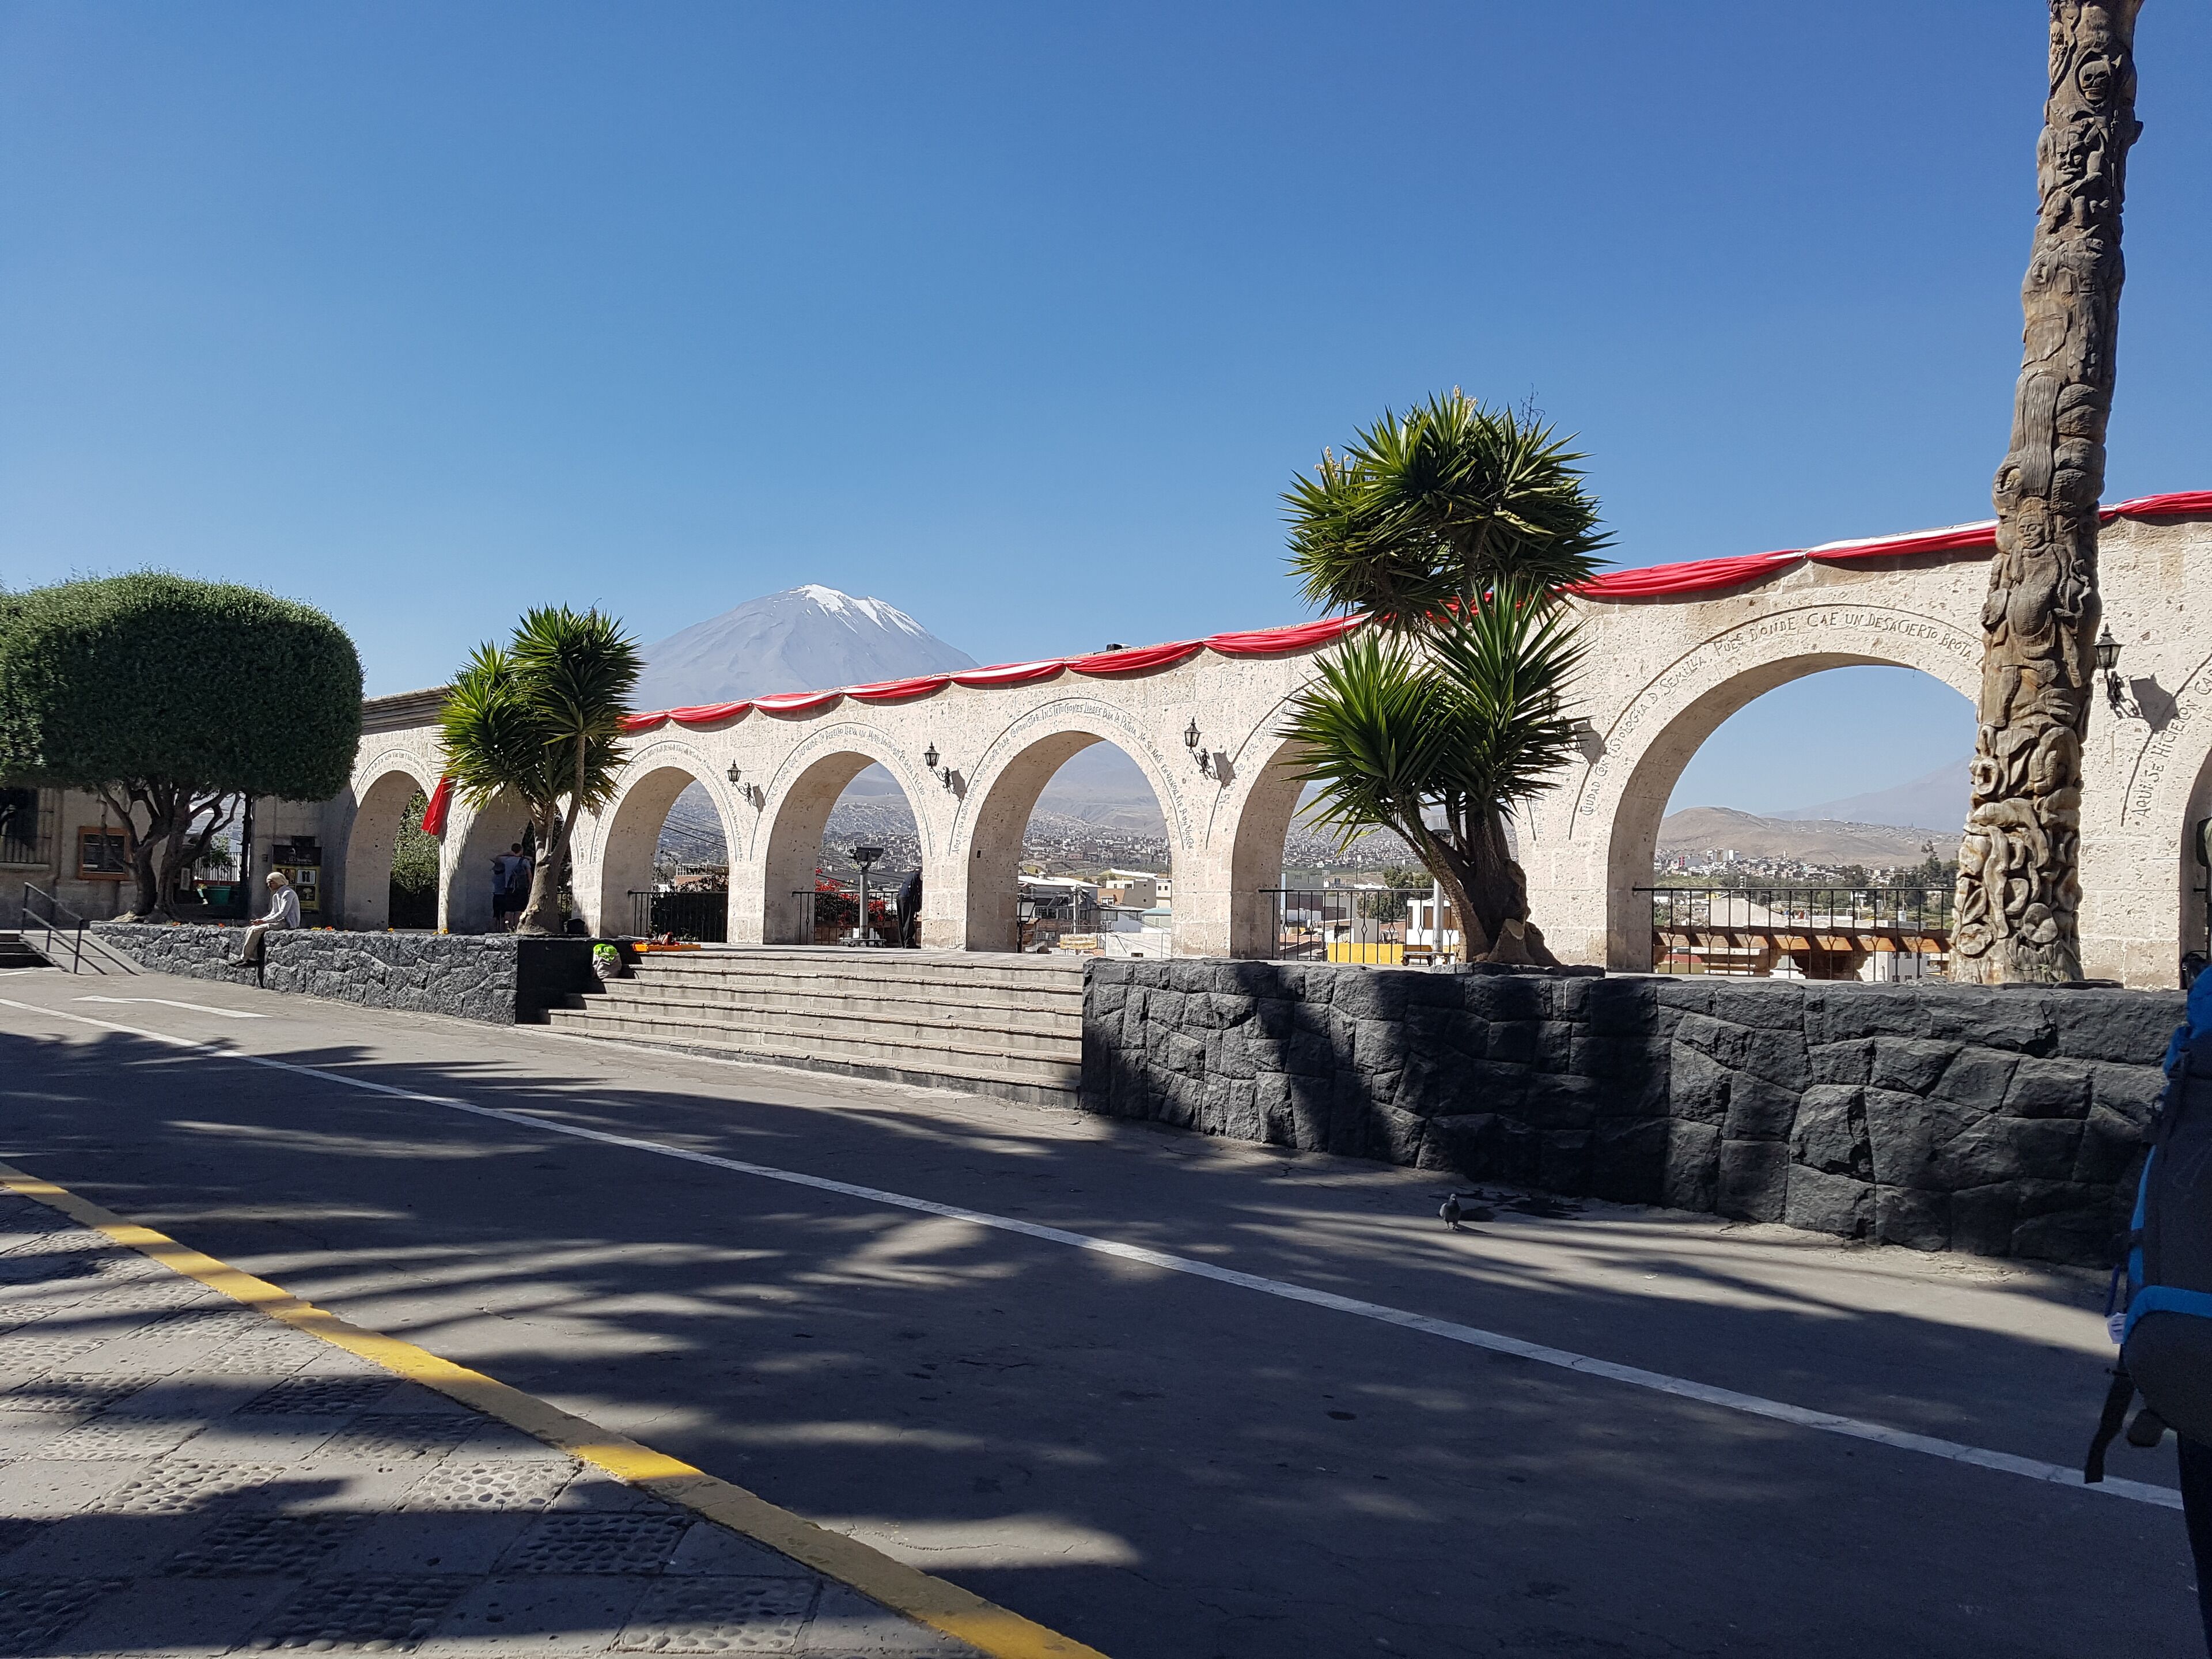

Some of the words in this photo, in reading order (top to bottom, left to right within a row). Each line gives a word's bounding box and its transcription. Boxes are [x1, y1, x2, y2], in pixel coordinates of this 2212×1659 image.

[1041, 703, 1084, 720] INSTITUCIONES
[1114, 712, 1120, 723] LA
[1580, 782, 1600, 816] CIUDAD
[1714, 633, 1744, 656] PUES
[1750, 616, 1796, 642] DONDE
[1807, 612, 1839, 627] CAE
[1845, 613, 1863, 626] UN
[1868, 613, 1938, 638] DESACIERTO
[1938, 633, 1972, 659] BROTA
[844, 725, 857, 736] LLEVA
[2145, 763, 2164, 783] SE
